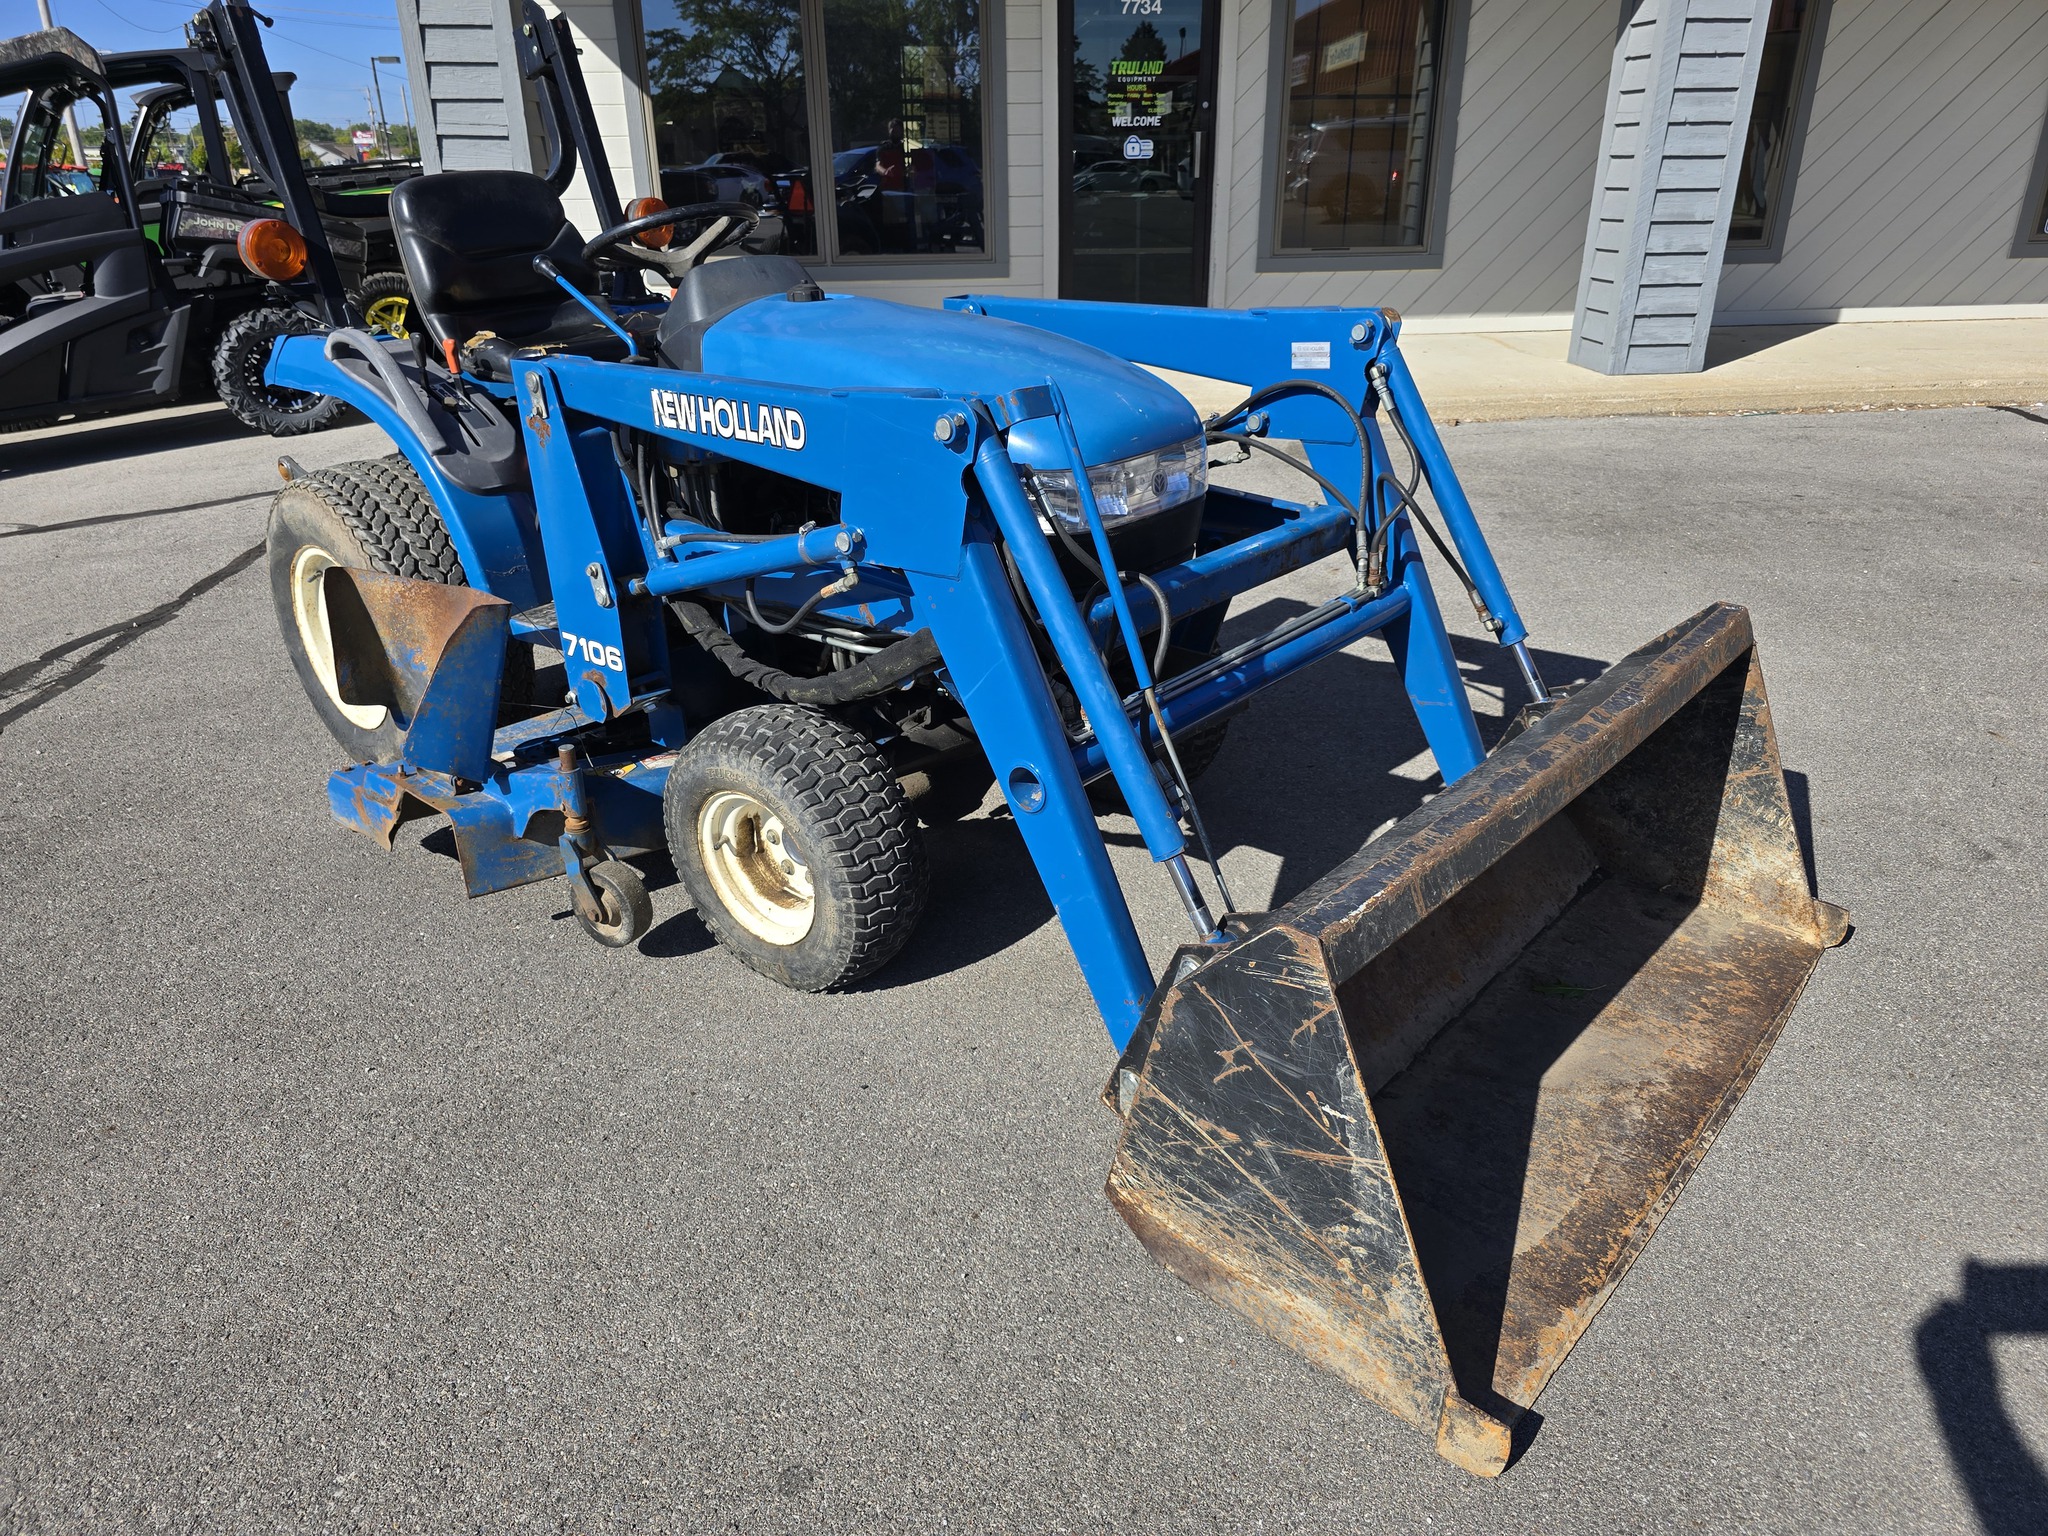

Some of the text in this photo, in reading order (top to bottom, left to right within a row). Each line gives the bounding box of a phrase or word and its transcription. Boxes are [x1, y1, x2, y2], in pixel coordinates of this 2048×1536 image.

[1121, 0, 1163, 15] 7734
[1111, 60, 1164, 75] TRULAND
[1111, 115, 1162, 127] WELCOME
[193, 217, 224, 229] JOHN
[650, 388, 807, 452] NEW HOLLAND
[561, 631, 624, 672] 7106
